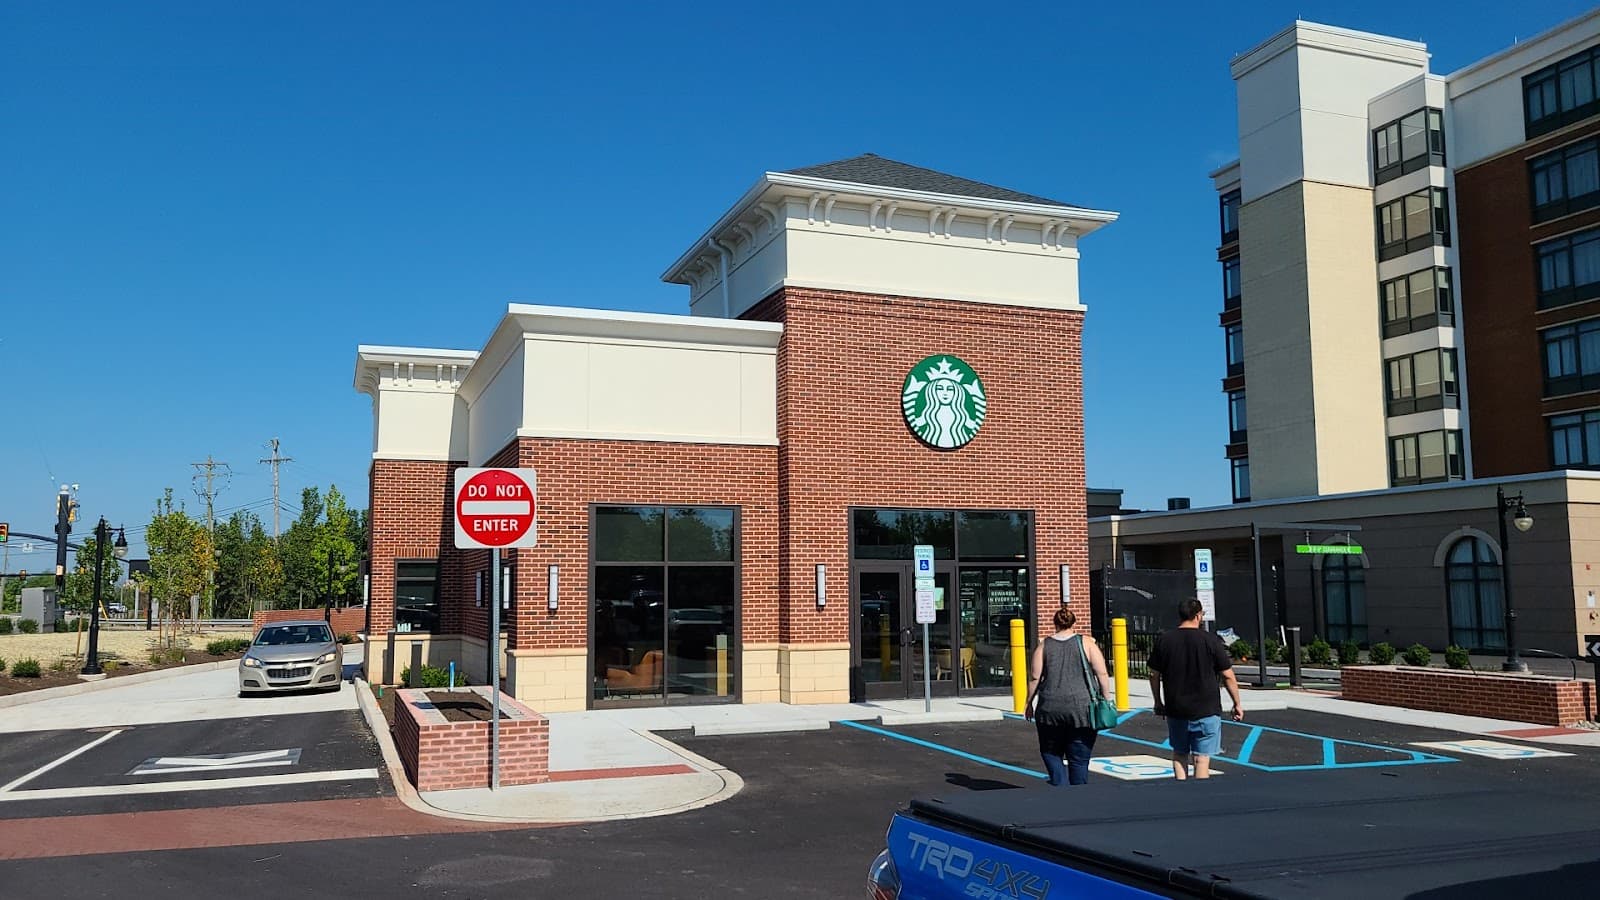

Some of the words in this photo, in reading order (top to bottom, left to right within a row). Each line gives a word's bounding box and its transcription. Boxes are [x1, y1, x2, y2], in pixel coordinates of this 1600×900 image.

[468, 484, 488, 497] DO
[496, 484, 524, 497] NOT
[473, 519, 519, 532] ENTER
[908, 832, 974, 880] TRD
